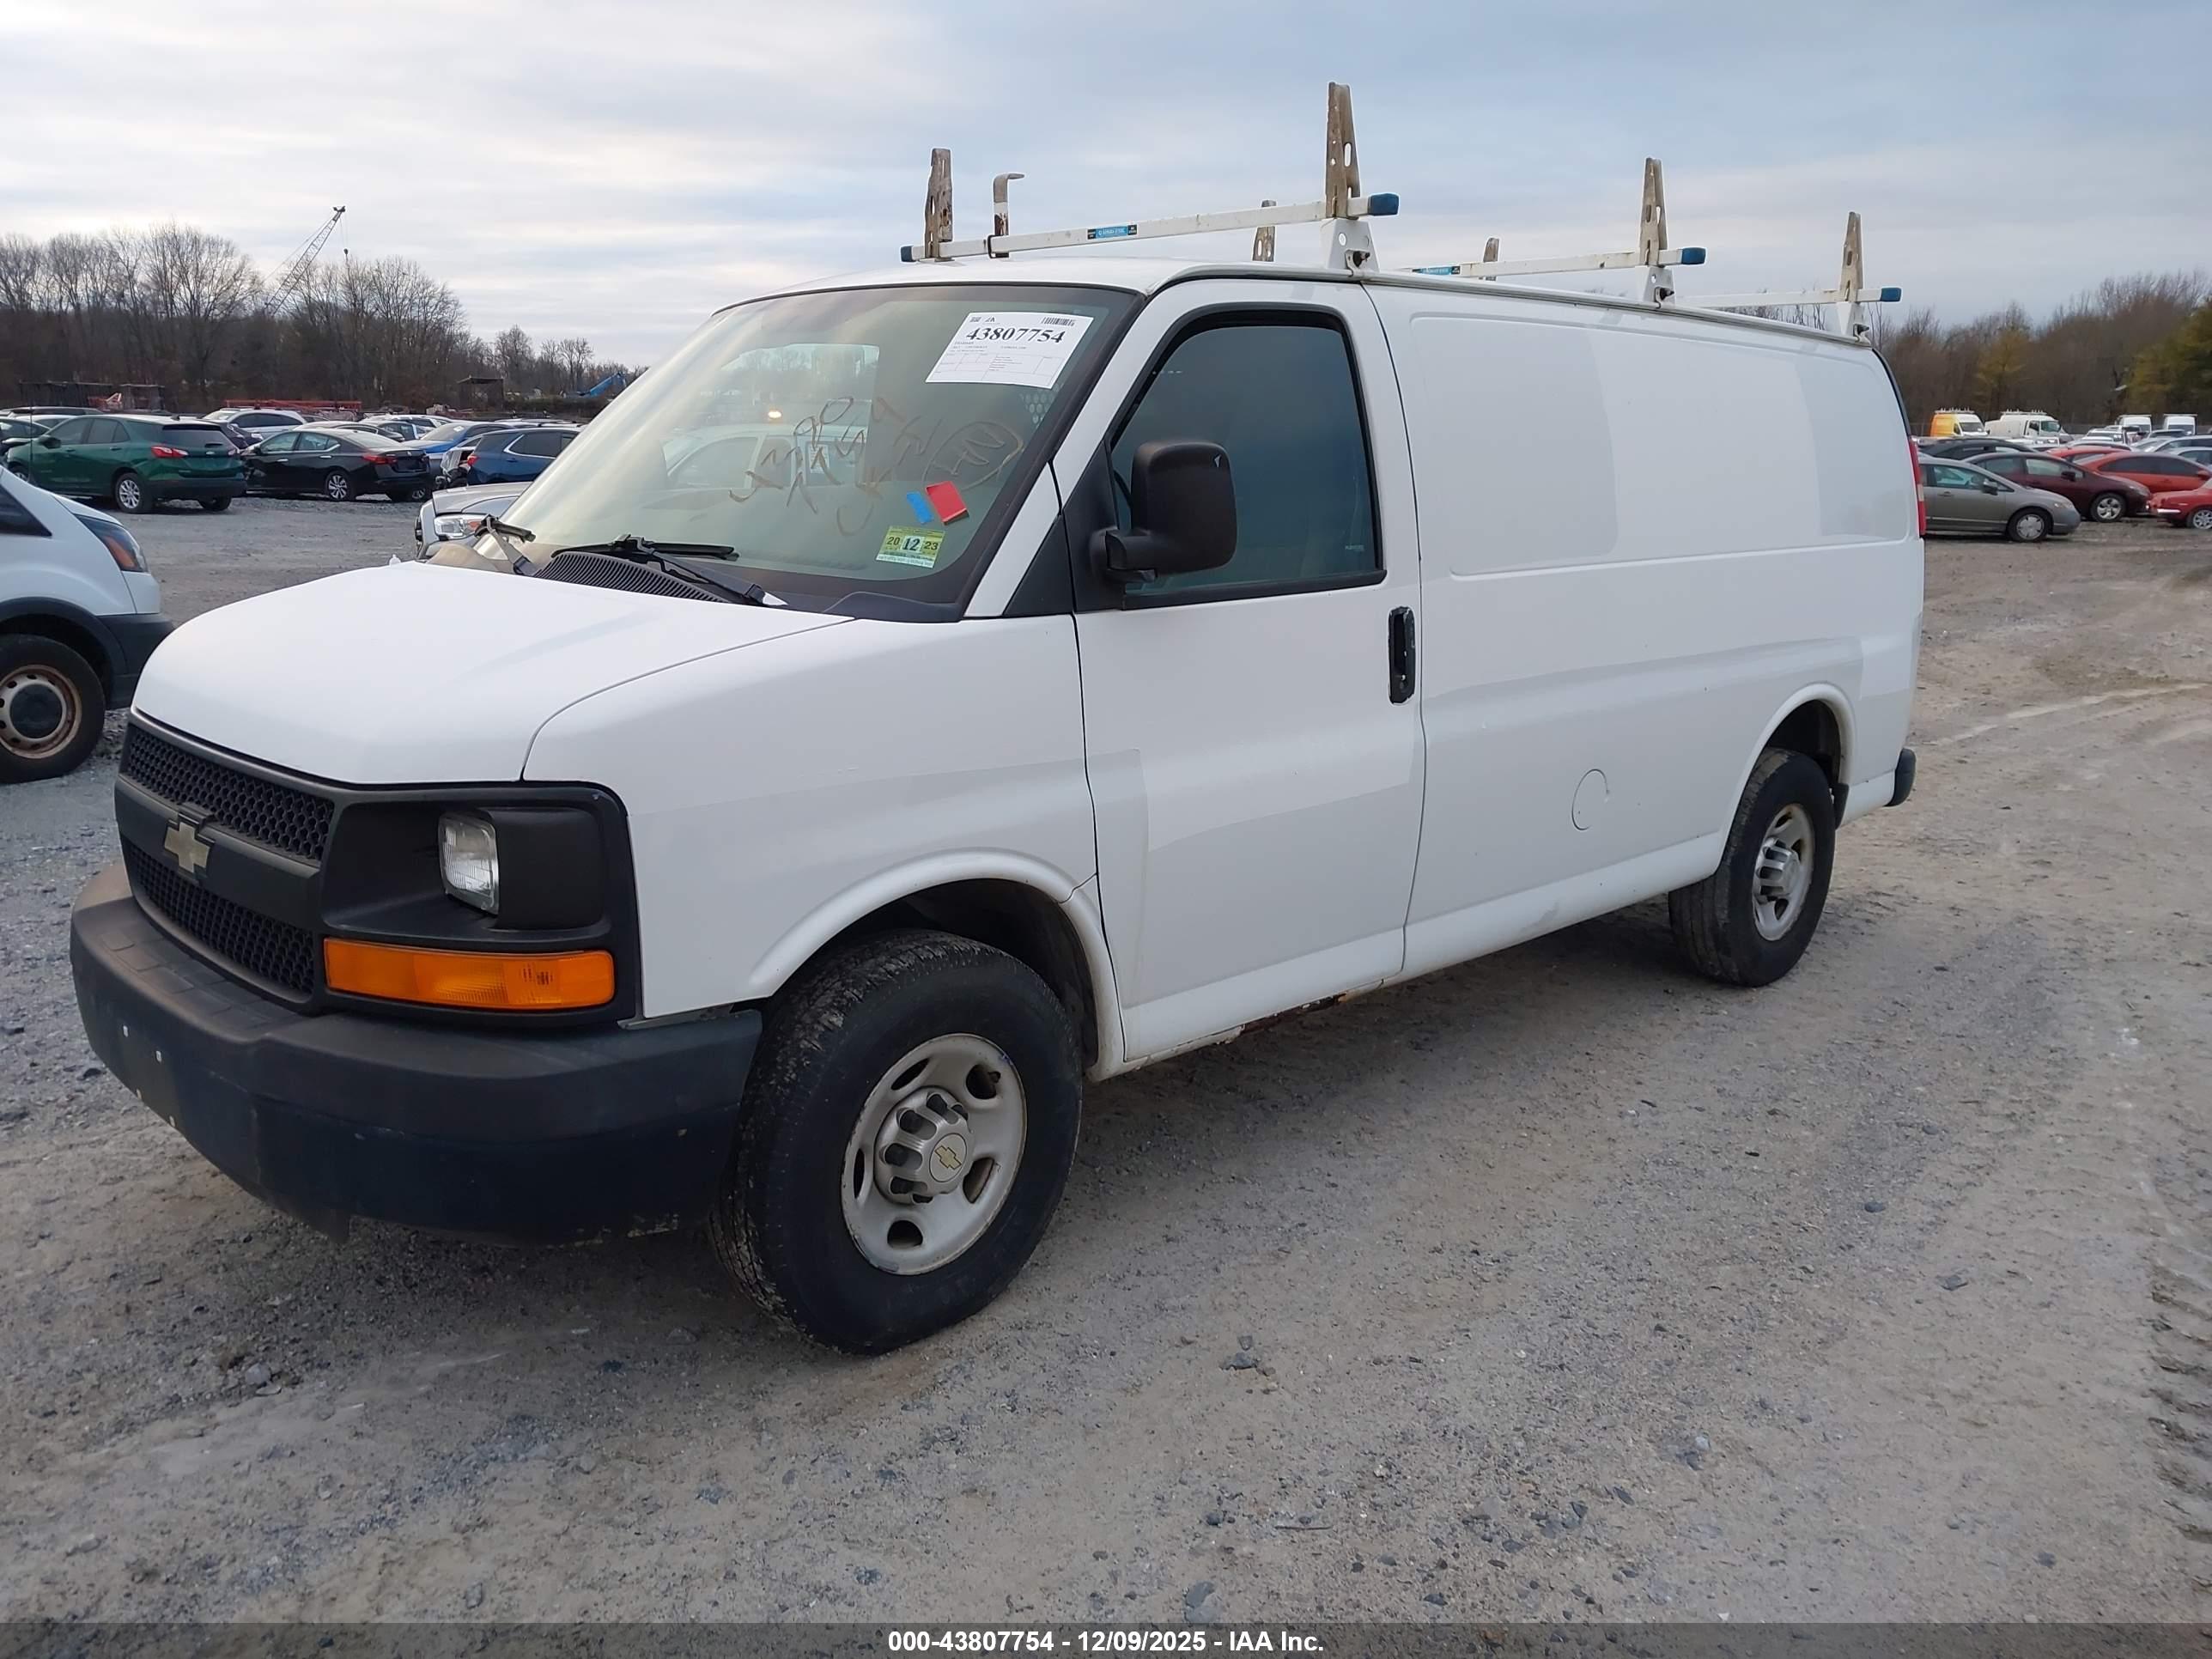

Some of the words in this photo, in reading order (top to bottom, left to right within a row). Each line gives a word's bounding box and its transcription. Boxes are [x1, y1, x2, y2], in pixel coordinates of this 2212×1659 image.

[966, 327, 1066, 343] 43807754
[887, 536, 901, 546] 20
[902, 538, 921, 551] 12
[924, 541, 939, 550] 23
